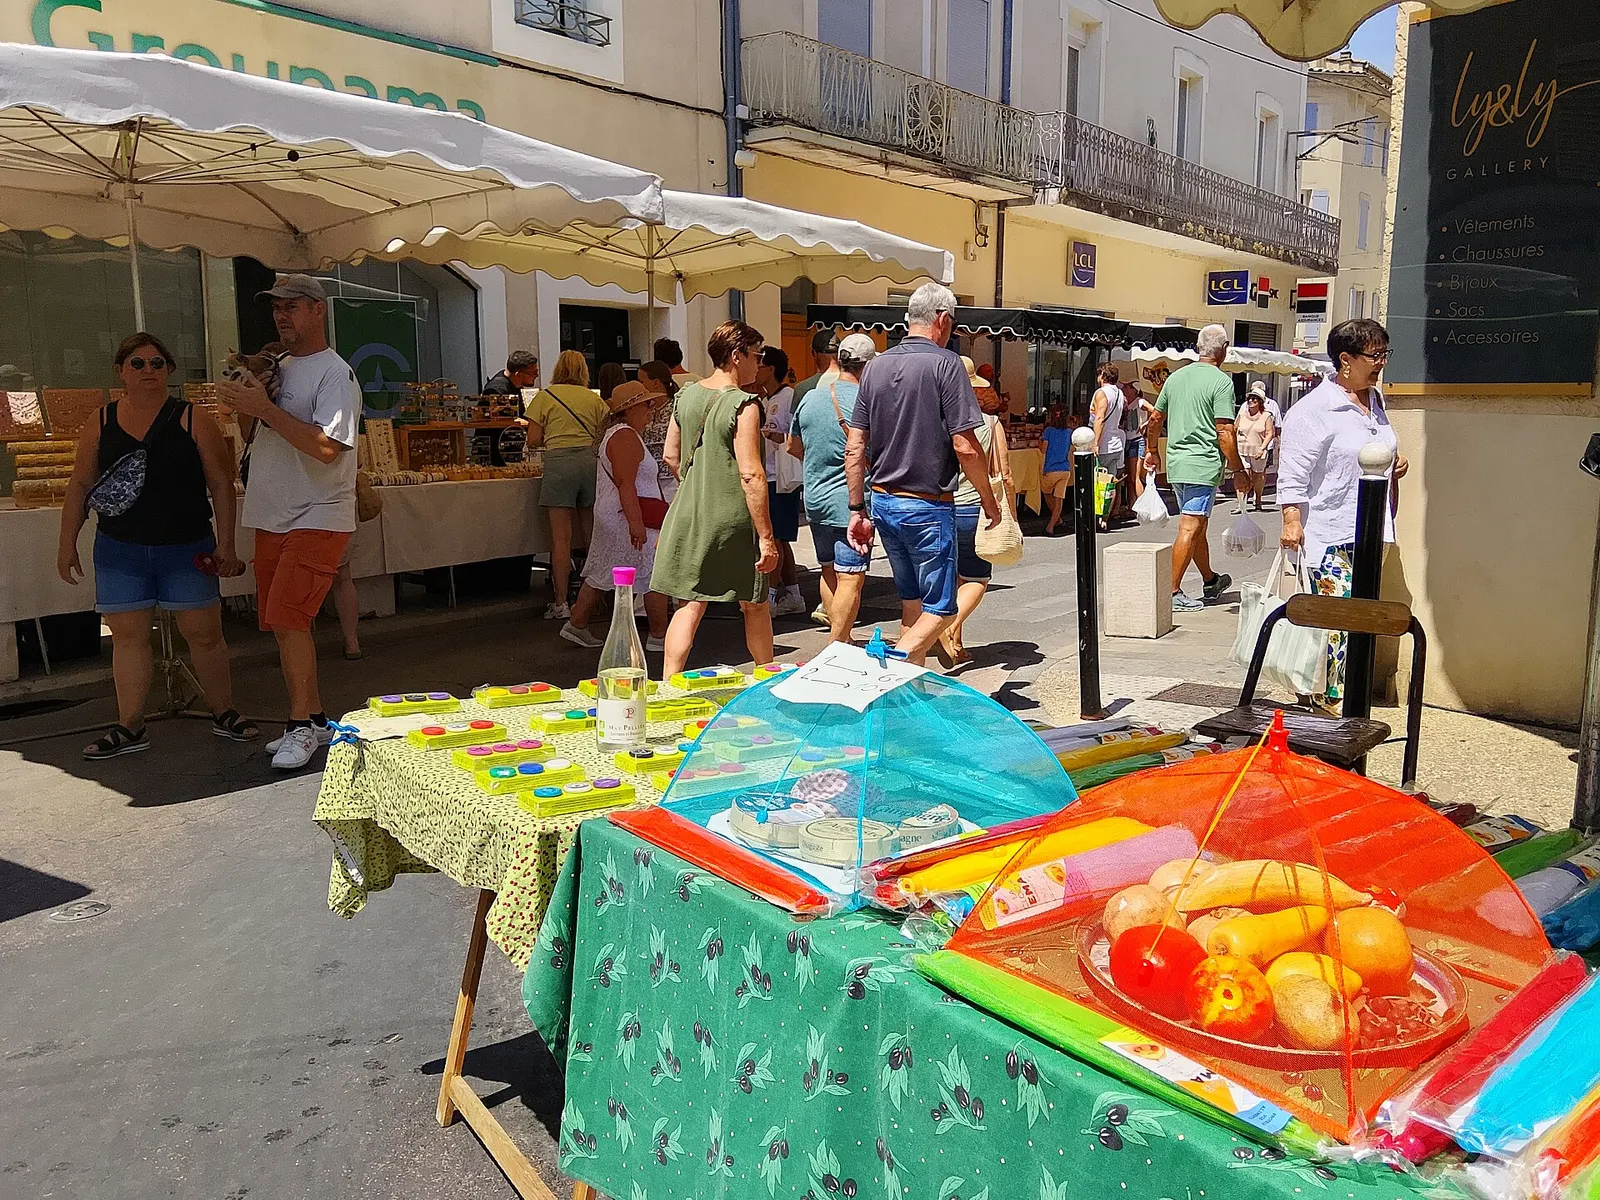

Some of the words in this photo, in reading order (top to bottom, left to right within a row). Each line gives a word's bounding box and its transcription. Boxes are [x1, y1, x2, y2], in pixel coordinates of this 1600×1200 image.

[1446, 156, 1549, 180] GALLERY
[1454, 215, 1535, 234] Vêtements
[1074, 252, 1094, 269] LCL
[1452, 244, 1545, 262] Chaussures
[1211, 279, 1244, 291] LCL
[1449, 274, 1499, 294] Bijoux
[1447, 301, 1485, 318] Sacs
[1444, 328, 1540, 345] Accessoires
